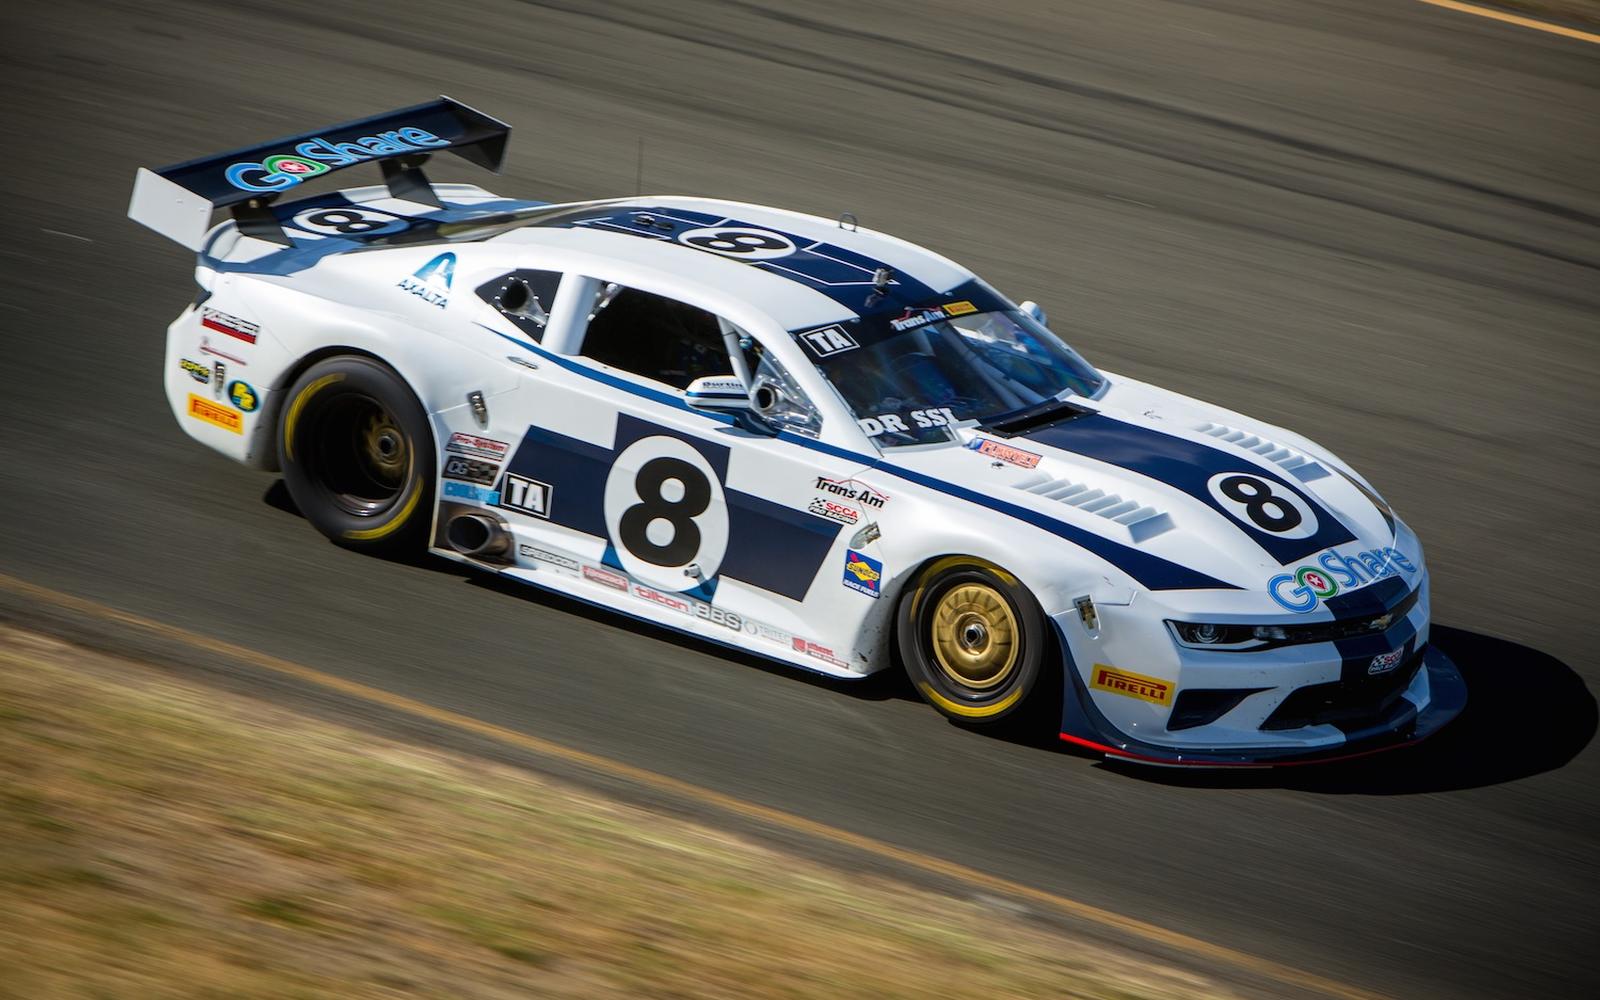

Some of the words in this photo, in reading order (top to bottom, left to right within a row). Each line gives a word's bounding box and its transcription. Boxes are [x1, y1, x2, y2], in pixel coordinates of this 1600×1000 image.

[309, 209, 391, 233] 8
[686, 231, 789, 253] 8
[396, 277, 450, 310] AXALTA
[890, 314, 925, 331] Trans
[924, 310, 946, 323] Am
[807, 329, 853, 353] TA
[858, 414, 910, 438] DR
[508, 477, 545, 513] TA
[815, 476, 857, 500] Trans
[856, 490, 885, 508] Am
[1219, 475, 1302, 533] 8
[620, 456, 711, 568] 8
[825, 502, 859, 519] SCCA
[848, 563, 880, 580] SUNOCO
[634, 586, 689, 612] tilton
[695, 602, 742, 632] BBS
[1097, 669, 1168, 700] PIRELLI
